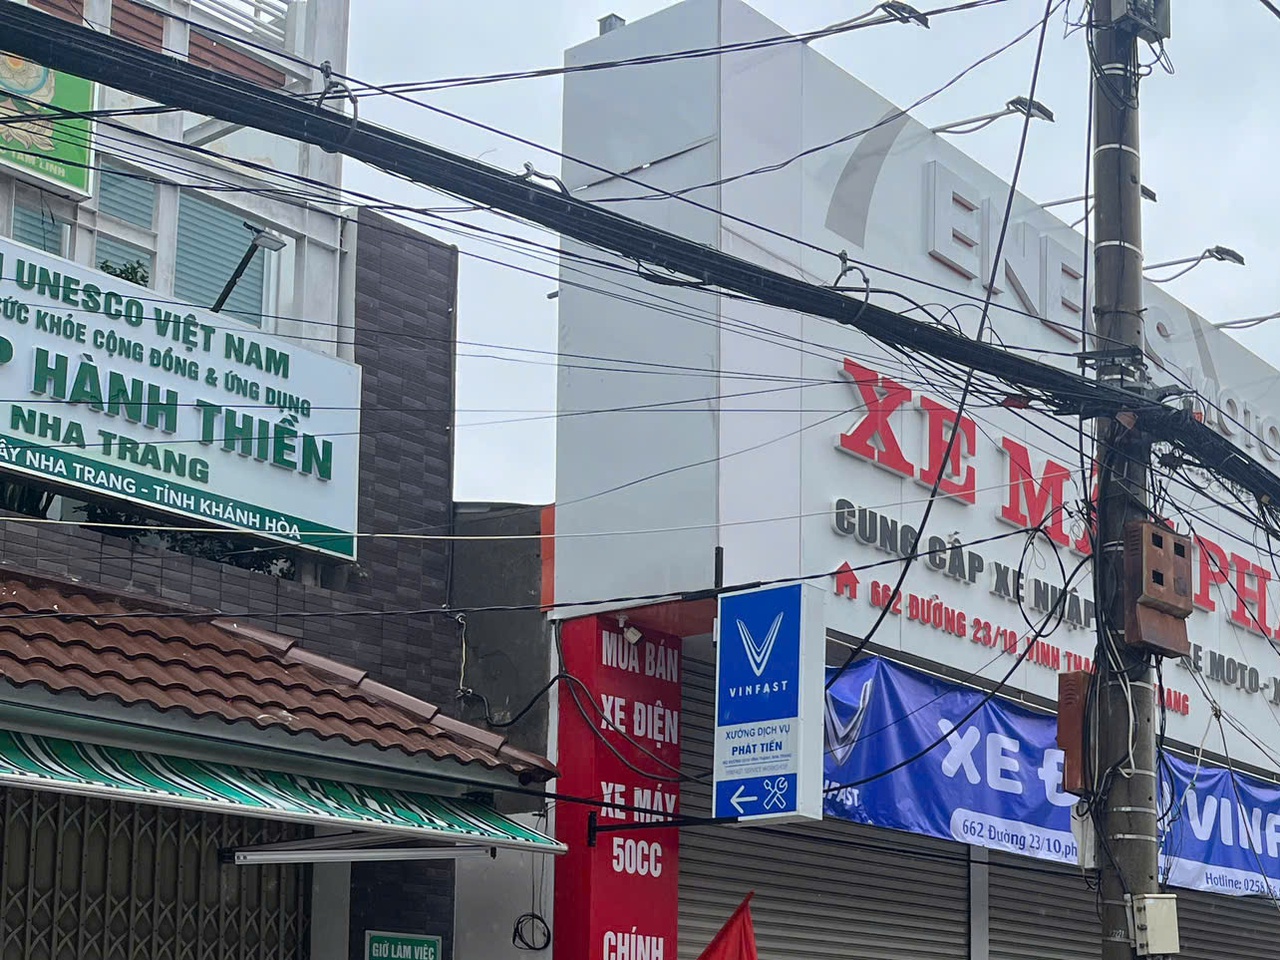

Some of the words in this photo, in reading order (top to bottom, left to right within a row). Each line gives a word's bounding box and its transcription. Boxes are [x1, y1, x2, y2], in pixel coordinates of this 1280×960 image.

[16, 258, 144, 327] UNESCO
[154, 307, 216, 351] VIỆT
[224, 333, 290, 379] NAM
[0, 295, 30, 325] ỨC
[35, 309, 87, 344] KHỎE
[93, 329, 144, 362] CỘNG
[205, 367, 218, 387] &
[224, 370, 260, 401] ỨNG
[265, 386, 311, 418] DỤNG
[31, 347, 179, 434] HÀNH
[195, 399, 333, 482] THIỀN
[836, 358, 976, 504] XE
[11, 404, 86, 449] NHA
[98, 429, 210, 484] TRANG
[0, 439, 21, 463] ÂY
[26, 450, 67, 475] NHA
[72, 463, 136, 493] TRANG
[153, 483, 195, 511] TỈNH
[200, 501, 260, 528] KHÁNH
[265, 511, 301, 540] HÒA
[991, 561, 1025, 603] XE
[908, 593, 966, 637] ĐƯỜNG
[602, 630, 640, 674] MUA
[645, 639, 679, 683] BÁN
[729, 680, 789, 698] VINFAST
[601, 693, 627, 734] XE
[633, 699, 679, 748] ĐIỆN
[779, 724, 791, 735] VỤ
[937, 718, 1023, 794] XE
[601, 781, 627, 820] XE
[633, 783, 677, 823] MÁY
[612, 836, 663, 878] 50CC
[962, 819, 984, 838] 662
[988, 824, 1026, 850] Đường
[1205, 872, 1242, 890] Hotline:
[372, 940, 390, 957] GIỜ
[391, 942, 412, 959] LÀM
